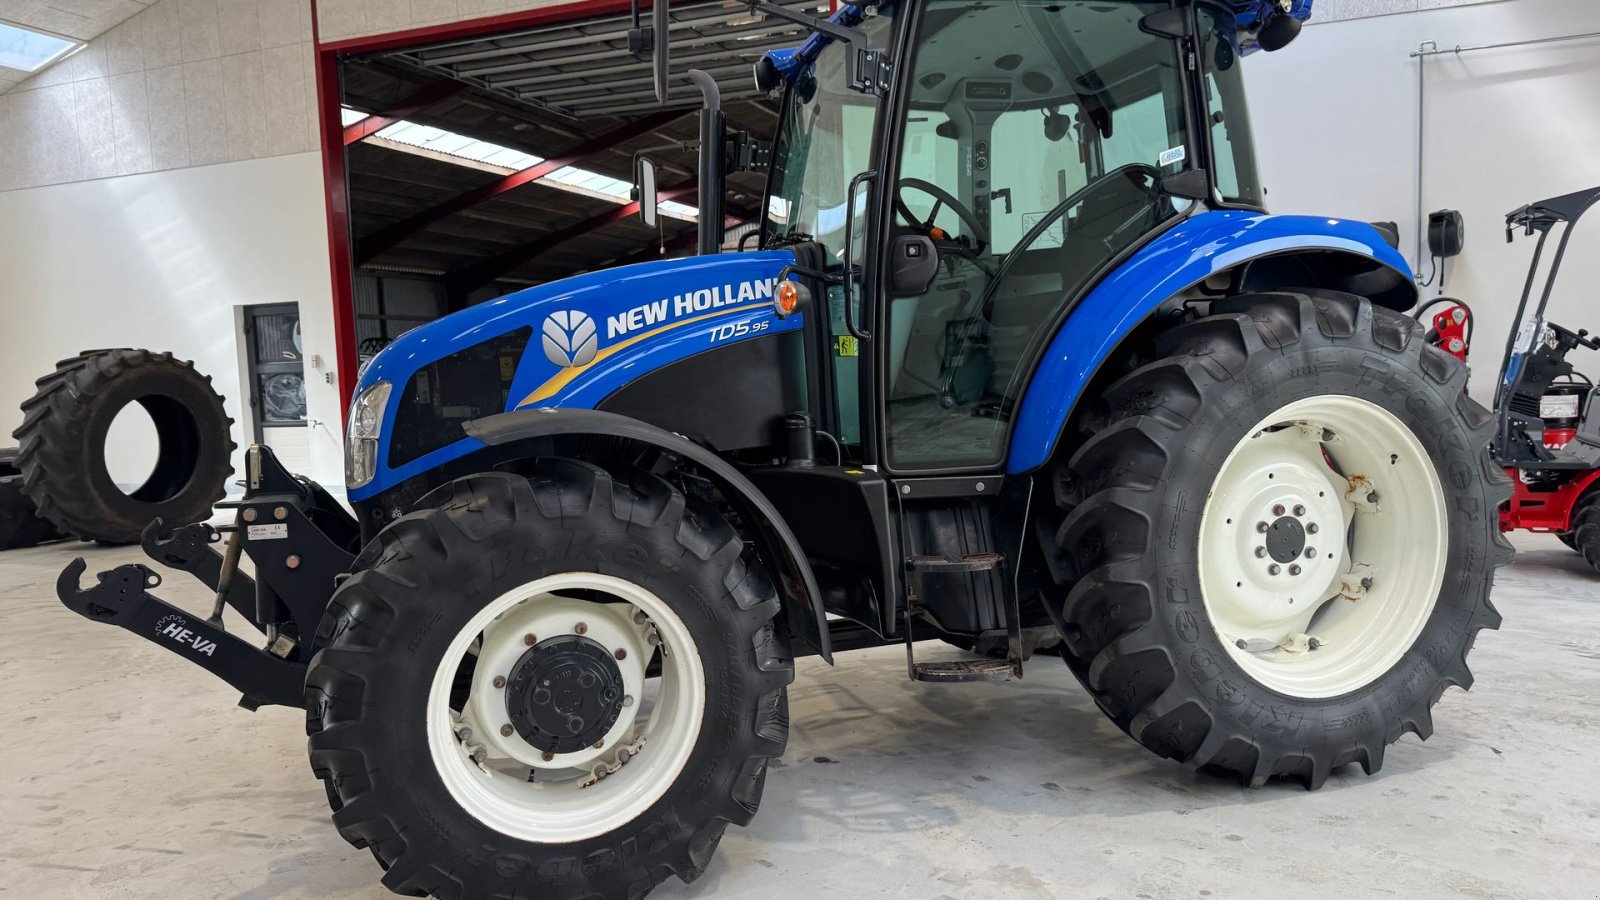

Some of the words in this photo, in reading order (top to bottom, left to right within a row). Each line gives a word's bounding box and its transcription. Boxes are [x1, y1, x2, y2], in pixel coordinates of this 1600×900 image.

[607, 299, 669, 339] NEW
[674, 278, 781, 317] HOLLAN
[709, 320, 770, 343] TD5.95
[162, 622, 217, 657] HE-VA
